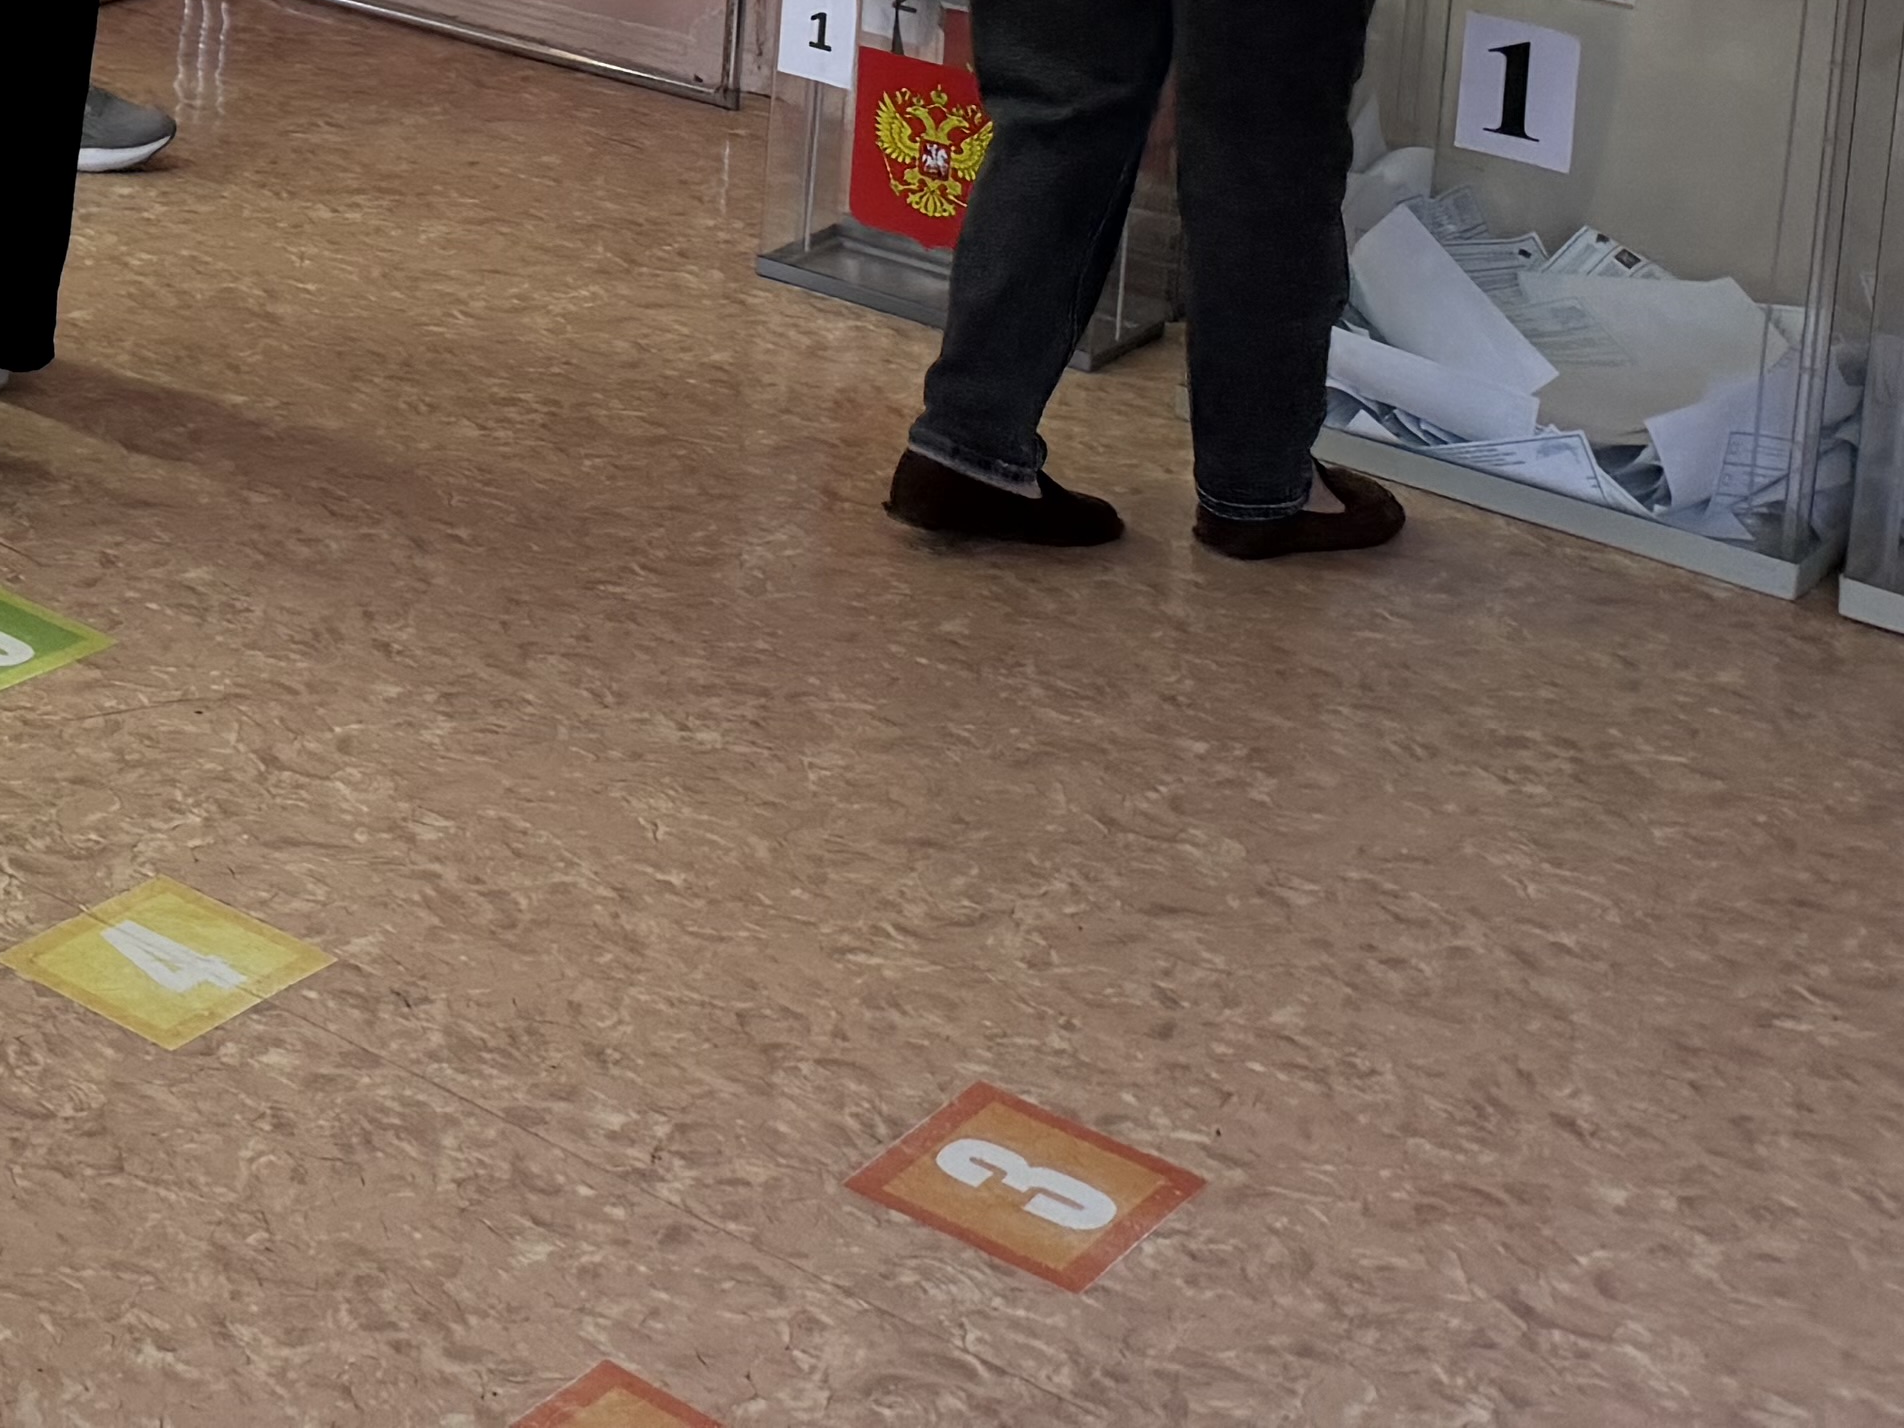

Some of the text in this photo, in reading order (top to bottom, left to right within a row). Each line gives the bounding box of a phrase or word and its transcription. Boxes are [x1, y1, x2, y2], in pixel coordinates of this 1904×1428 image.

[808, 11, 832, 52] 1
[1482, 41, 1540, 143] 1
[99, 919, 248, 992] 4
[935, 1137, 1118, 1231] 3
